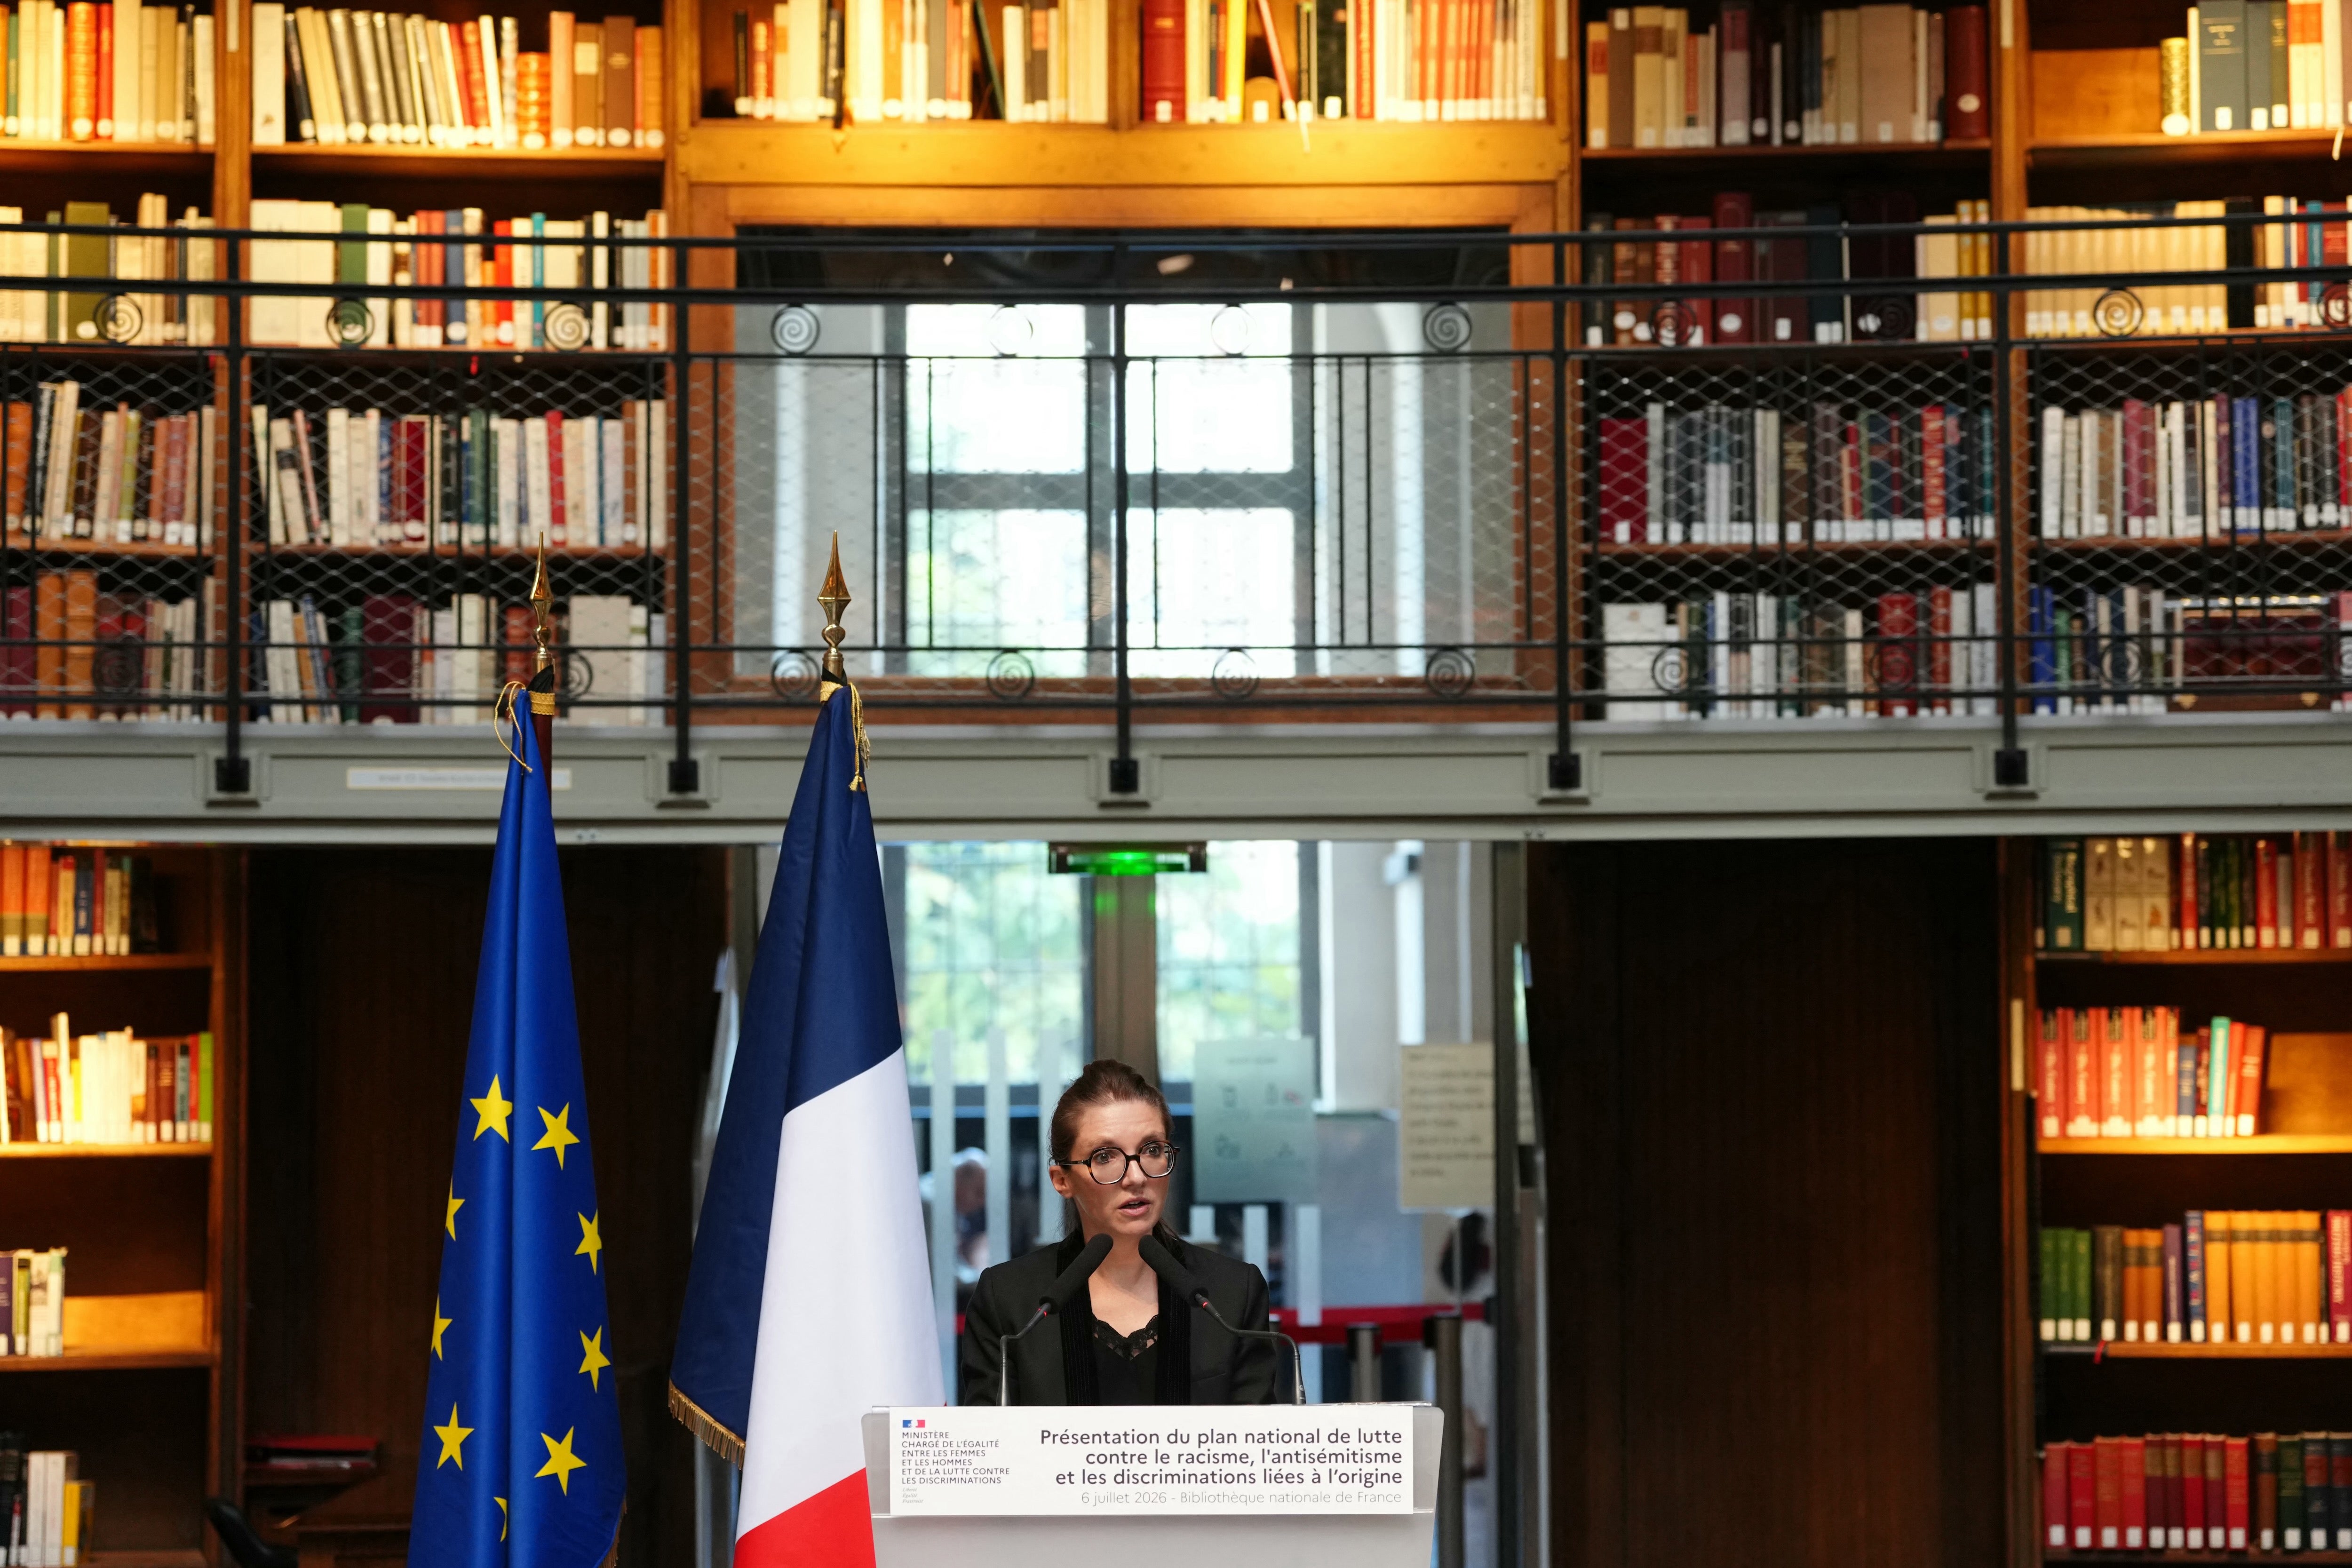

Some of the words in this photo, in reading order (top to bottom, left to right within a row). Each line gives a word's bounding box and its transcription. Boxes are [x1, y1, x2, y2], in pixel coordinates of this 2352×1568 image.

[902, 1430, 949, 1439] MINISTÈRE
[1041, 1428, 1160, 1445] Présentation
[1167, 1428, 1190, 1444] du
[1198, 1428, 1237, 1448] plan
[1245, 1428, 1320, 1444] national
[1327, 1428, 1351, 1444] de
[1358, 1428, 1402, 1444] lutte
[1086, 1451, 1147, 1465] contre
[1155, 1449, 1170, 1465] le
[1177, 1450, 1255, 1467] racisme,
[1262, 1448, 1402, 1464] l'antisémitisme
[1056, 1471, 1075, 1485] et
[1082, 1469, 1106, 1485] les
[1113, 1468, 1256, 1485] discriminations
[1263, 1468, 1304, 1484] liées
[1311, 1468, 1321, 1484] à
[1081, 1492, 1089, 1504] 6
[1092, 1491, 1129, 1507] juillet
[1135, 1492, 1167, 1504] 2026
[1181, 1491, 1264, 1506] Bibliothèque
[1270, 1491, 1331, 1503] nationale
[1335, 1491, 1352, 1503] de
[1358, 1491, 1401, 1503] France
